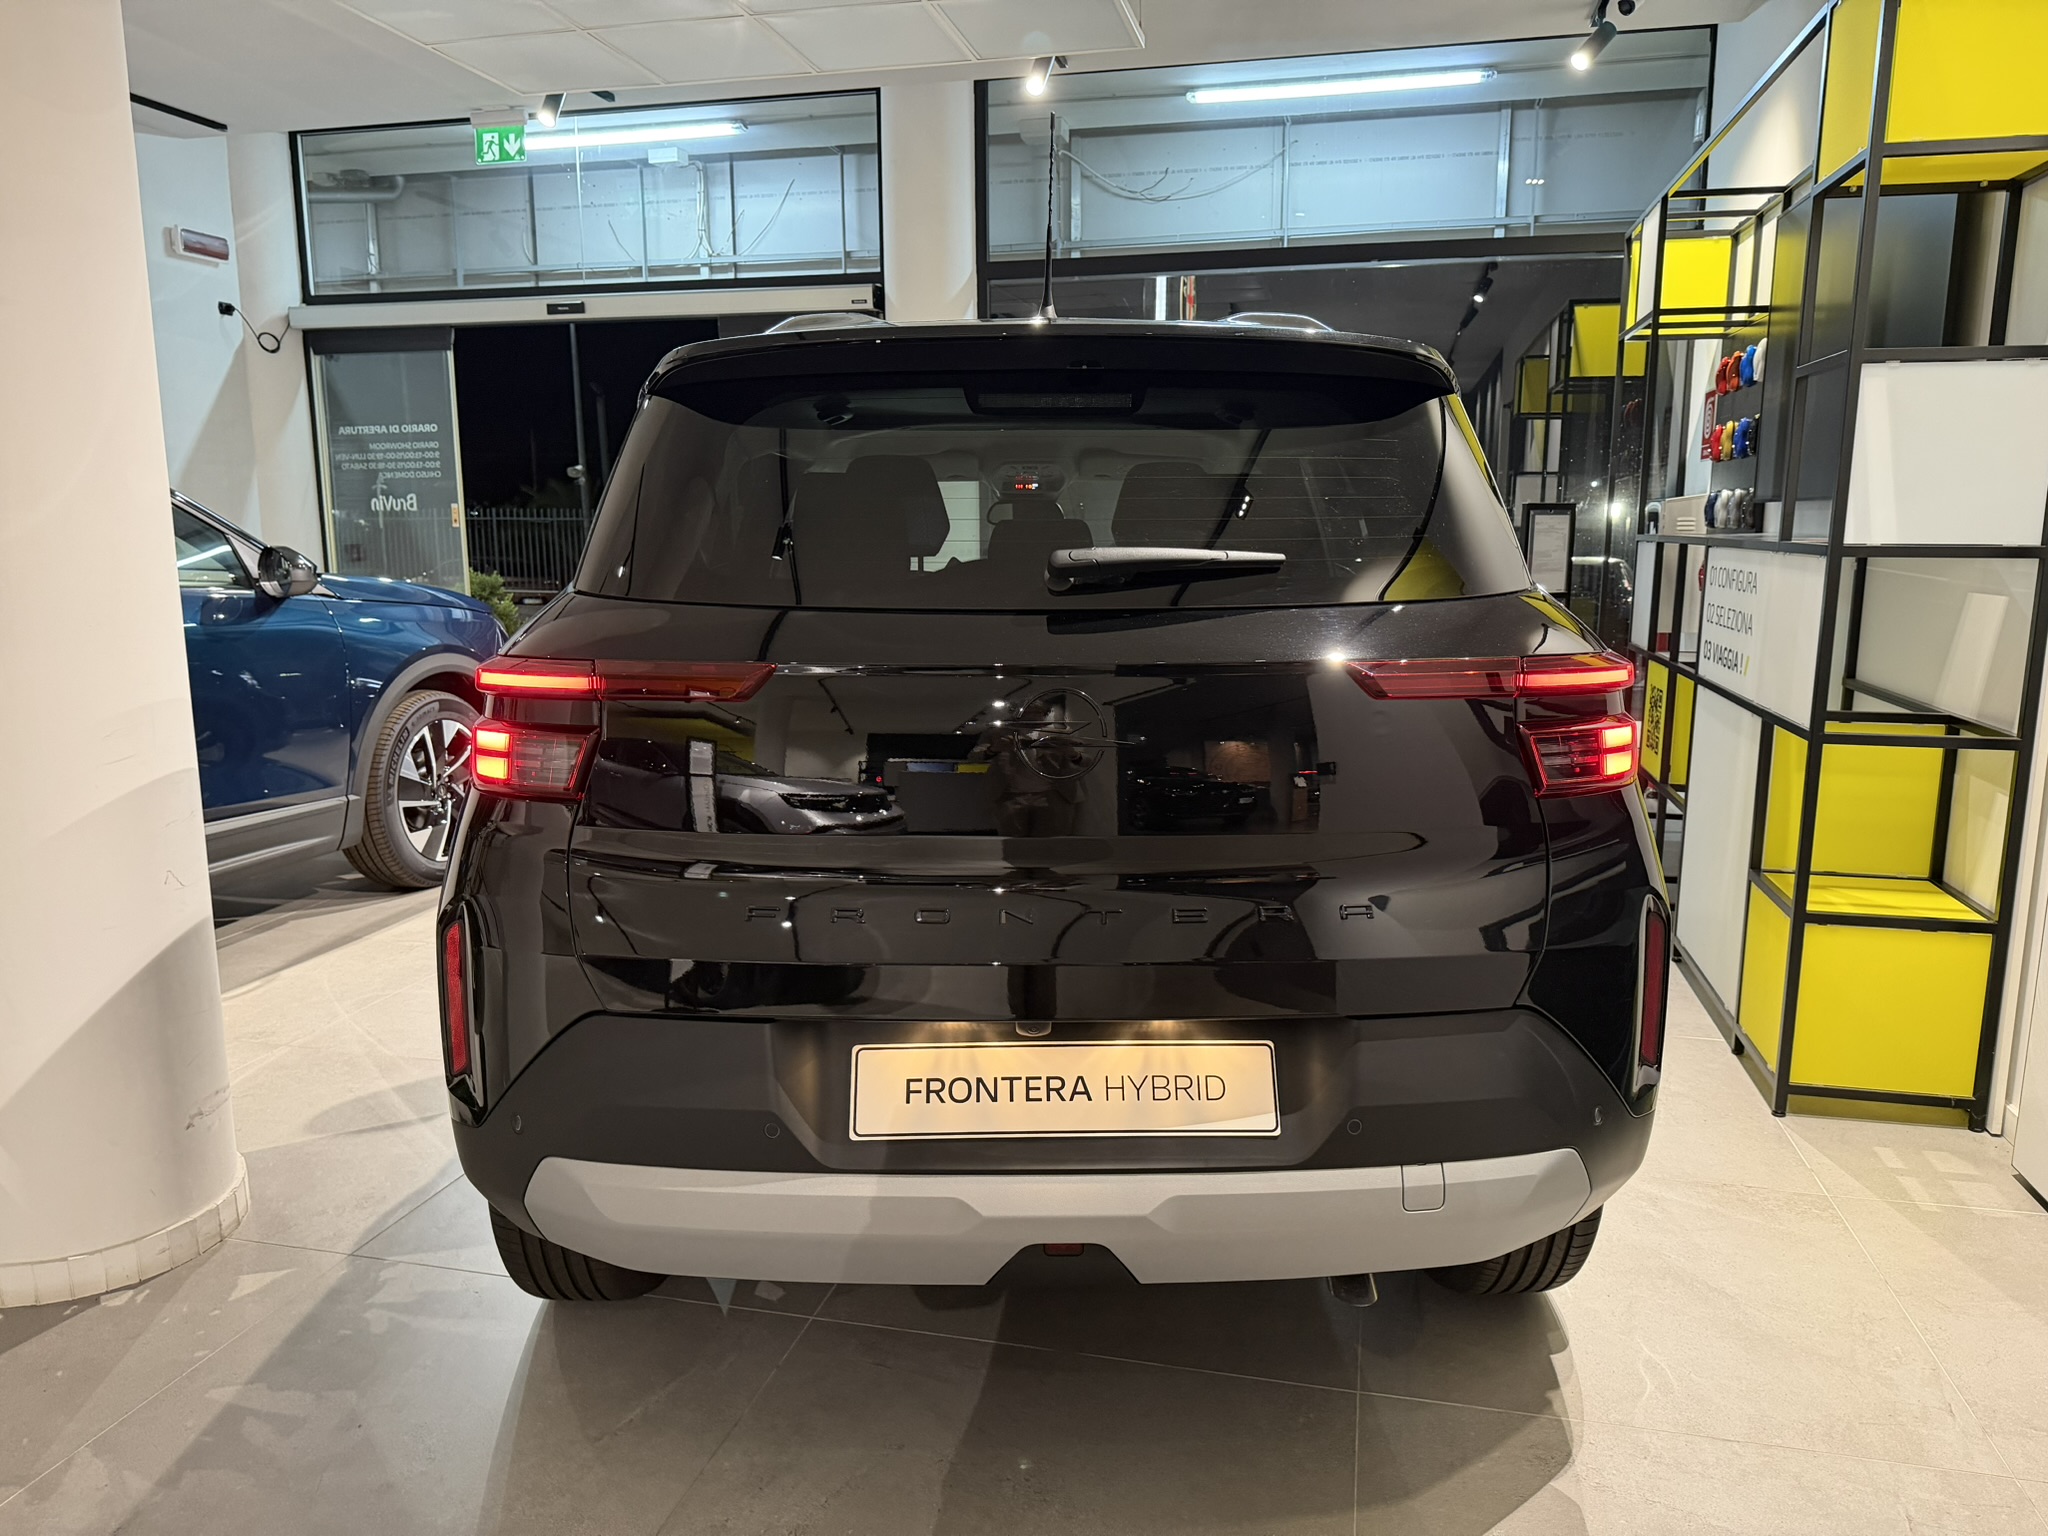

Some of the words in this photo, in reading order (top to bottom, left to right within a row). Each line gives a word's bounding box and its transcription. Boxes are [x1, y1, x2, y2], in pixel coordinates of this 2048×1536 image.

[1710, 566, 1718, 586] 01
[1717, 566, 1758, 595] CONFIGURA
[1707, 603, 1715, 623] 02
[1714, 604, 1753, 637] SELEZIONA
[1703, 639, 1713, 661] 03
[1712, 642, 1739, 673] VIAGGIA
[388, 728, 410, 785] MICHELIN
[744, 904, 1375, 925] FRONTERA
[905, 1075, 1093, 1104] FRONTERA
[1105, 1074, 1226, 1102] HYBRID
